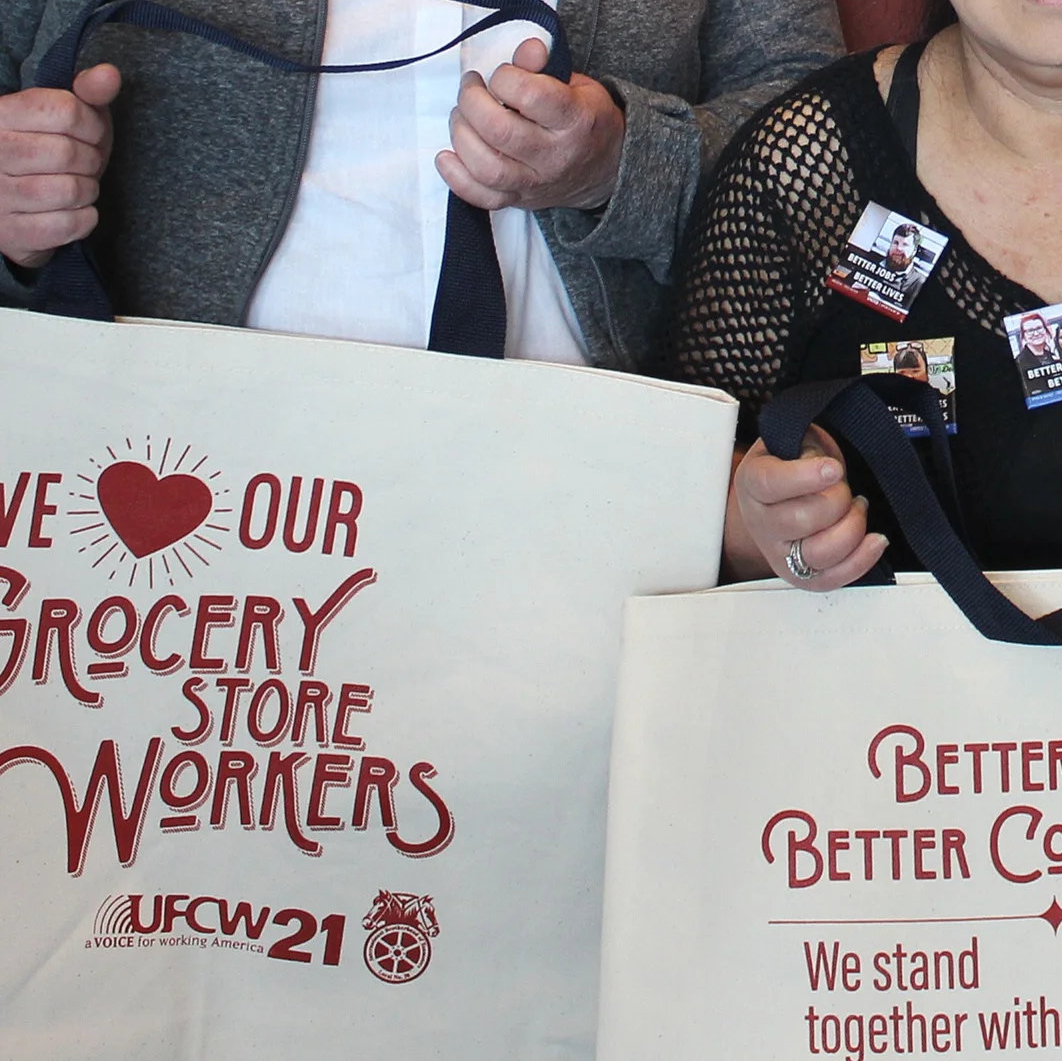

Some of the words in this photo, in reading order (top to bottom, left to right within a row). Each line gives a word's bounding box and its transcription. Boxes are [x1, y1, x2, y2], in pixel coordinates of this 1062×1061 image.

[847, 253, 877, 274] BETTER
[875, 267, 897, 283] JOBS
[853, 271, 882, 292] BETTER
[881, 285, 905, 302] LIVES
[1027, 362, 1062, 380] BETTER
[238, 472, 364, 558] OUR
[170, 677, 375, 752] STORE
[0, 737, 456, 879] WORKERS
[761, 809, 972, 889] BETTER
[84, 939, 92, 949] a
[94, 936, 134, 948] VOICE
[137, 935, 155, 948] for
[160, 934, 207, 949] working
[211, 936, 264, 954] America
[127, 894, 271, 940] UFCW
[267, 909, 346, 966] 21
[803, 941, 862, 991] We
[873, 937, 980, 992] stand
[804, 1000, 968, 1061] together
[978, 995, 1061, 1051] with
